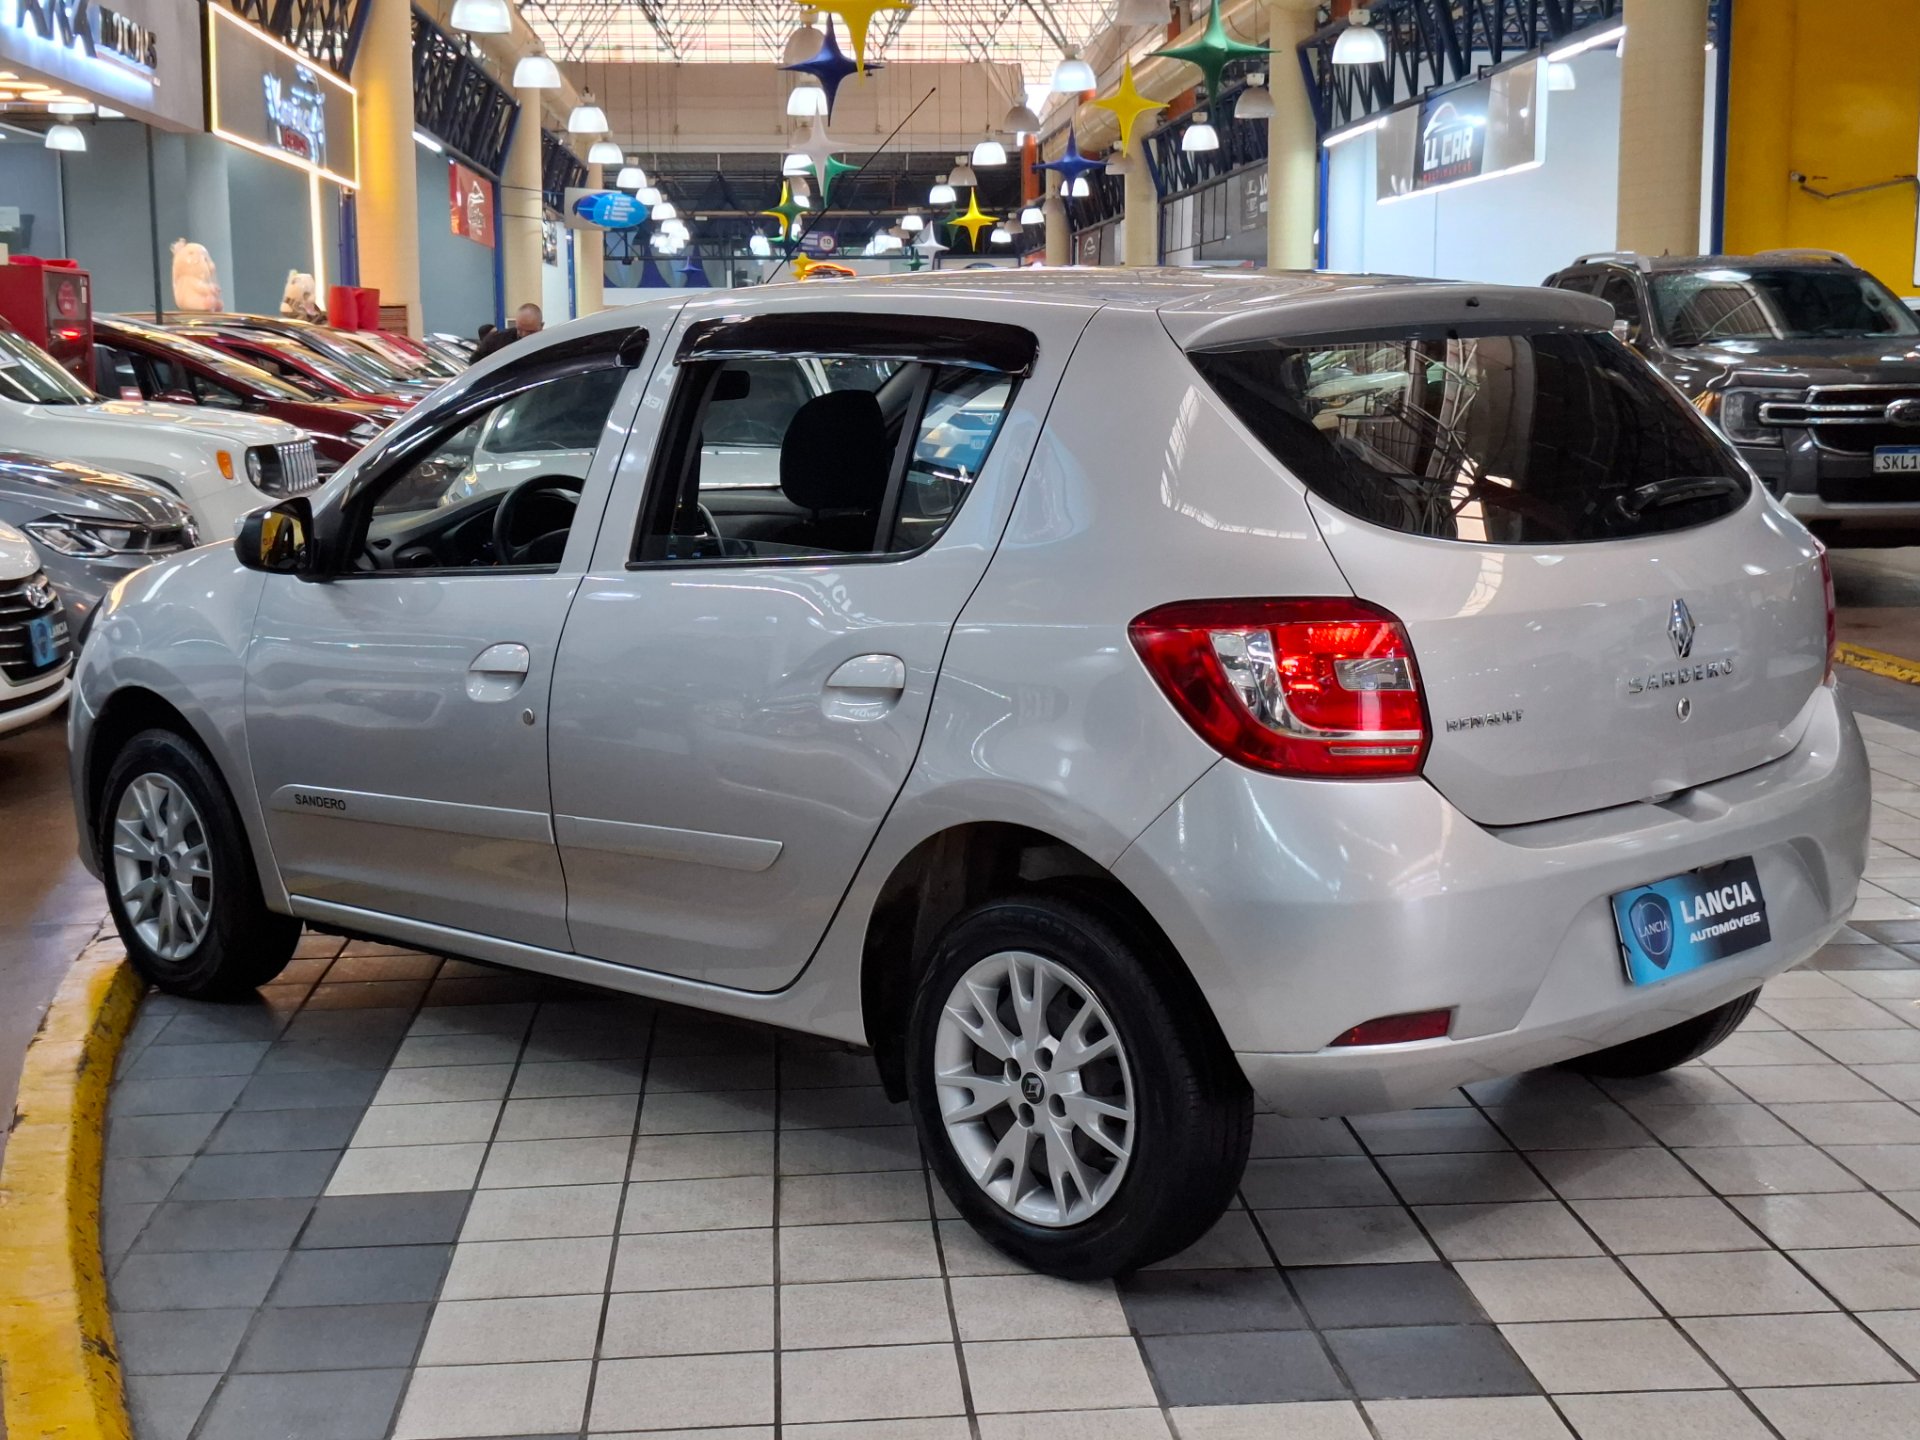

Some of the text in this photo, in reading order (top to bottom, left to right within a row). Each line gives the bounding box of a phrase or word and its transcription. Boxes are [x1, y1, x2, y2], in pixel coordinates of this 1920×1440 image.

[1441, 127, 1473, 166] CAR
[1882, 455, 1920, 470] SKL1
[1628, 657, 1734, 694] SANDERO
[1446, 708, 1524, 733] RENAULT
[294, 793, 347, 811] SANDERO
[1680, 881, 1756, 924] LANCIA
[1637, 919, 1670, 938] LANCIA
[1689, 911, 1761, 943] AUTOMÓVEIS
